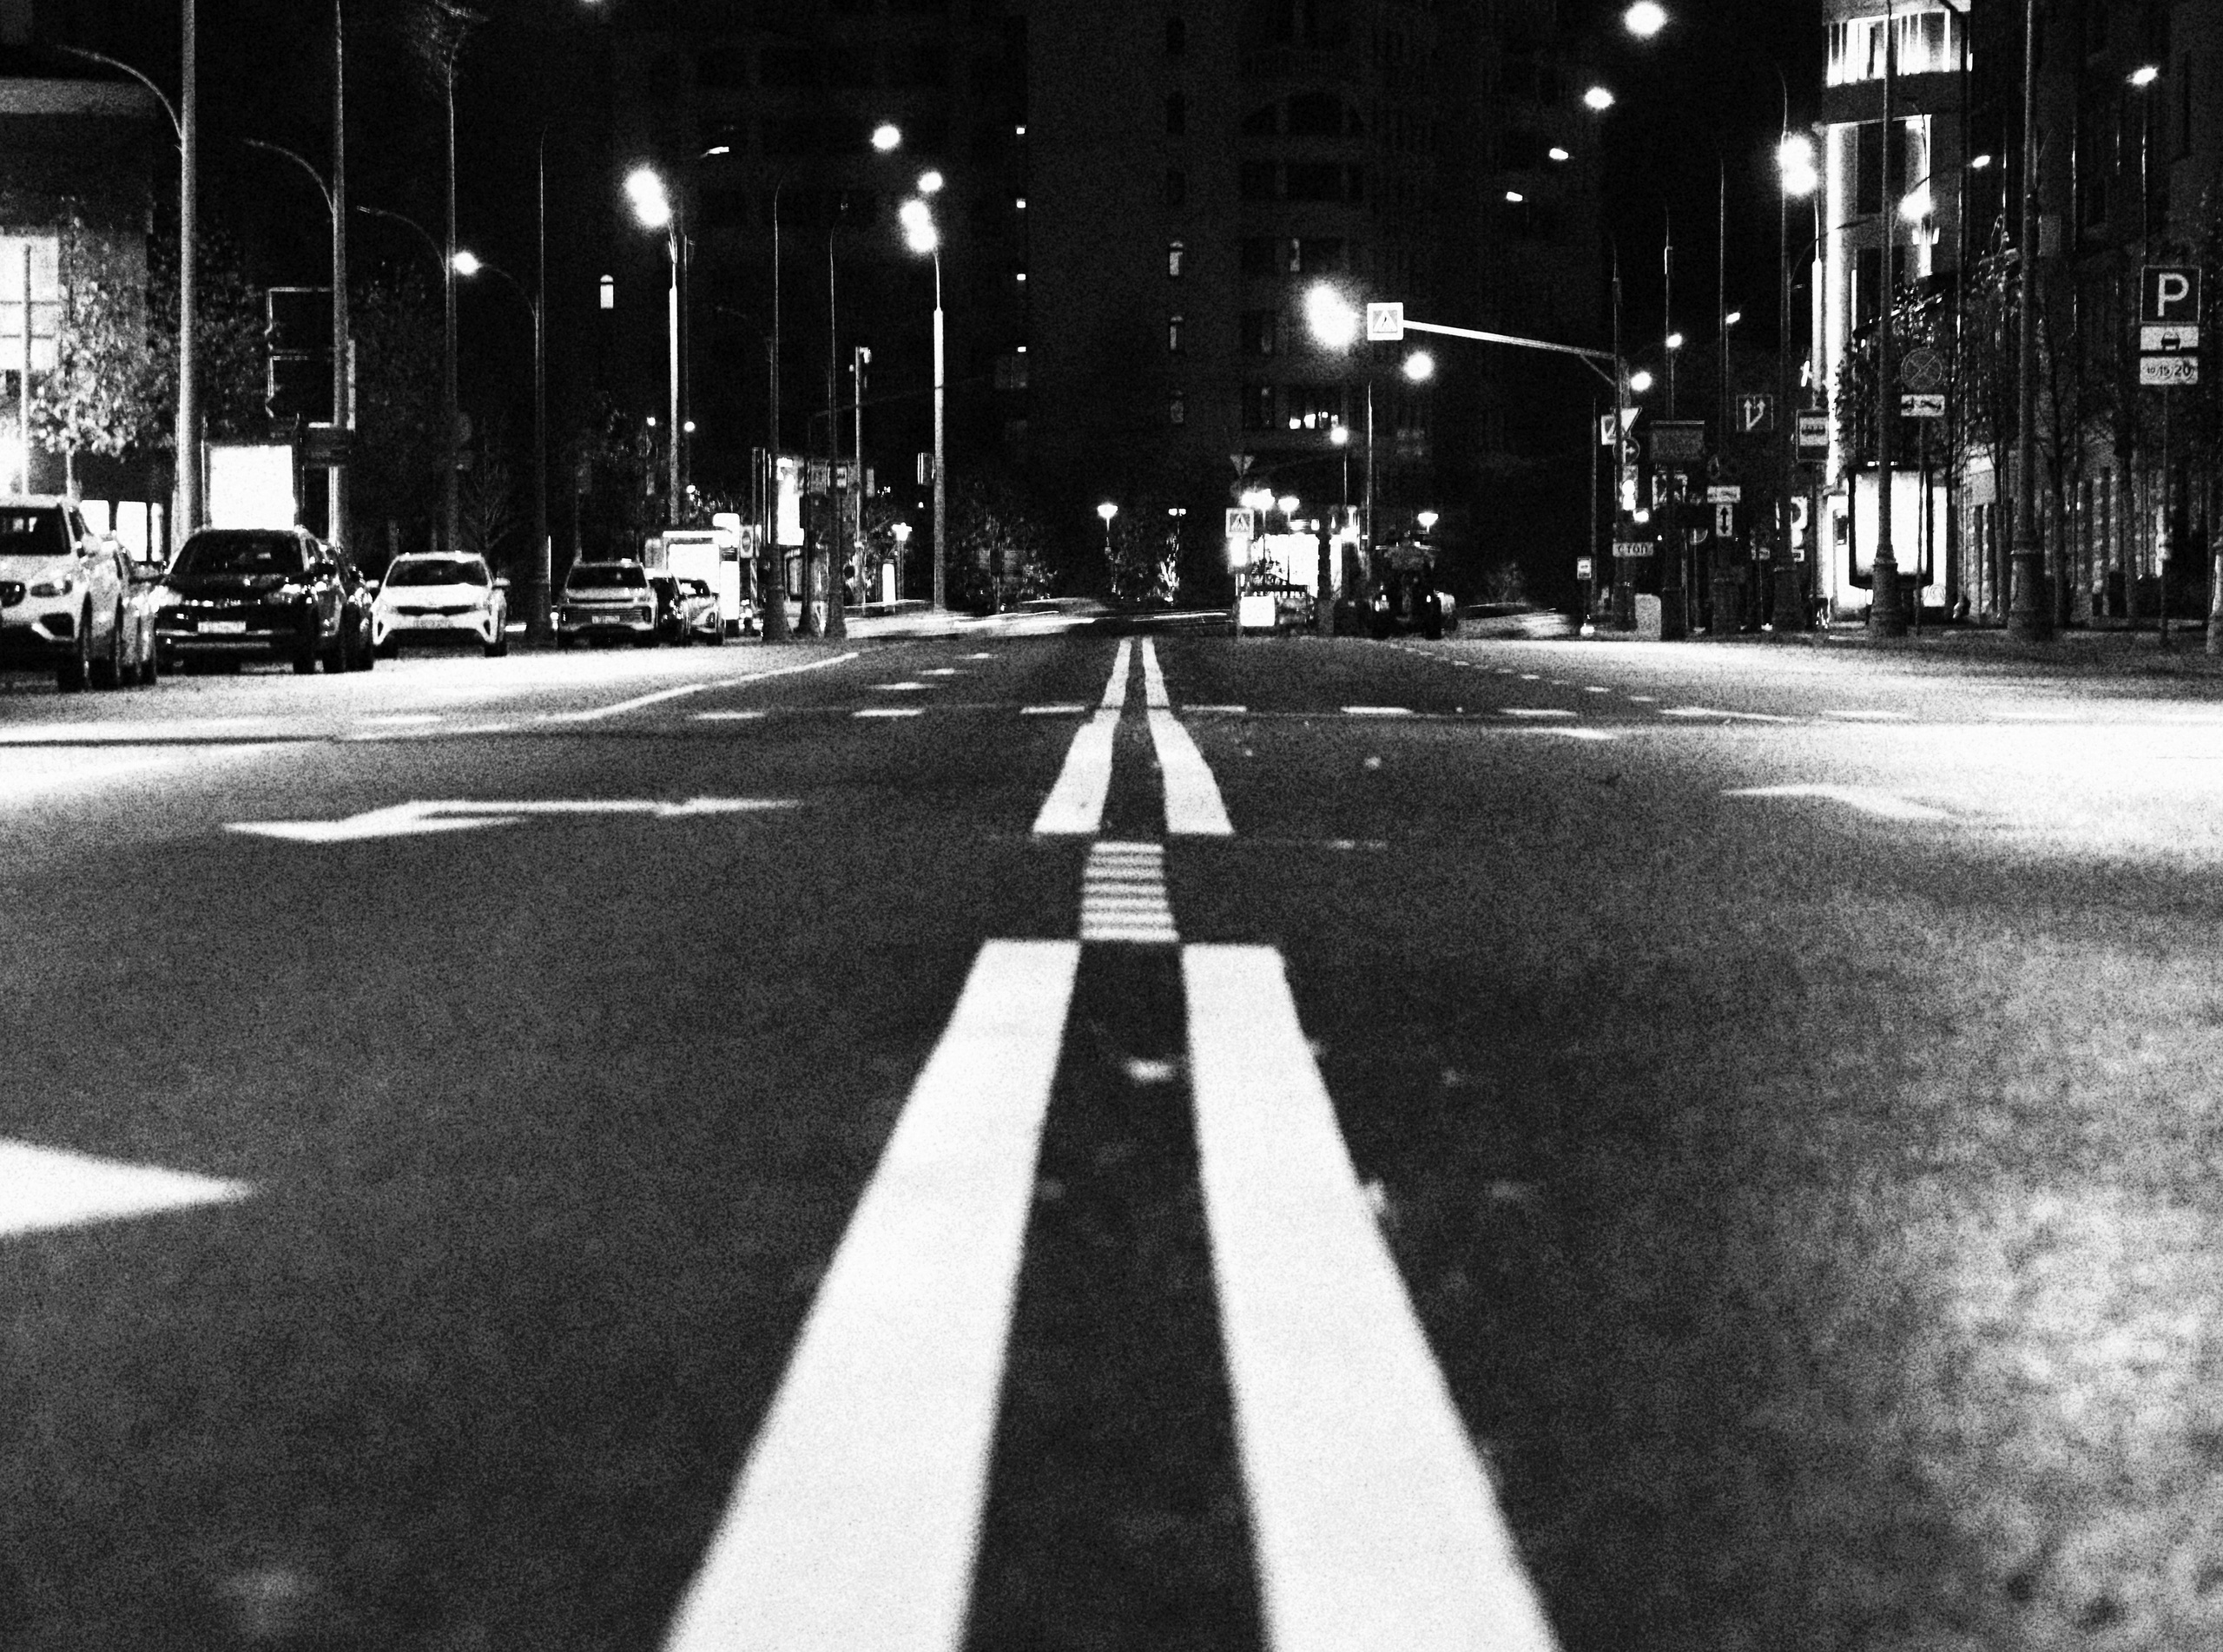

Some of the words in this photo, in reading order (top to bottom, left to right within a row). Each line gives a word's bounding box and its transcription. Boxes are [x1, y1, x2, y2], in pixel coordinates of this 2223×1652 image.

[2157, 273, 2189, 317] P
[2160, 365, 2170, 376] 15
[2174, 363, 2191, 376] 20
